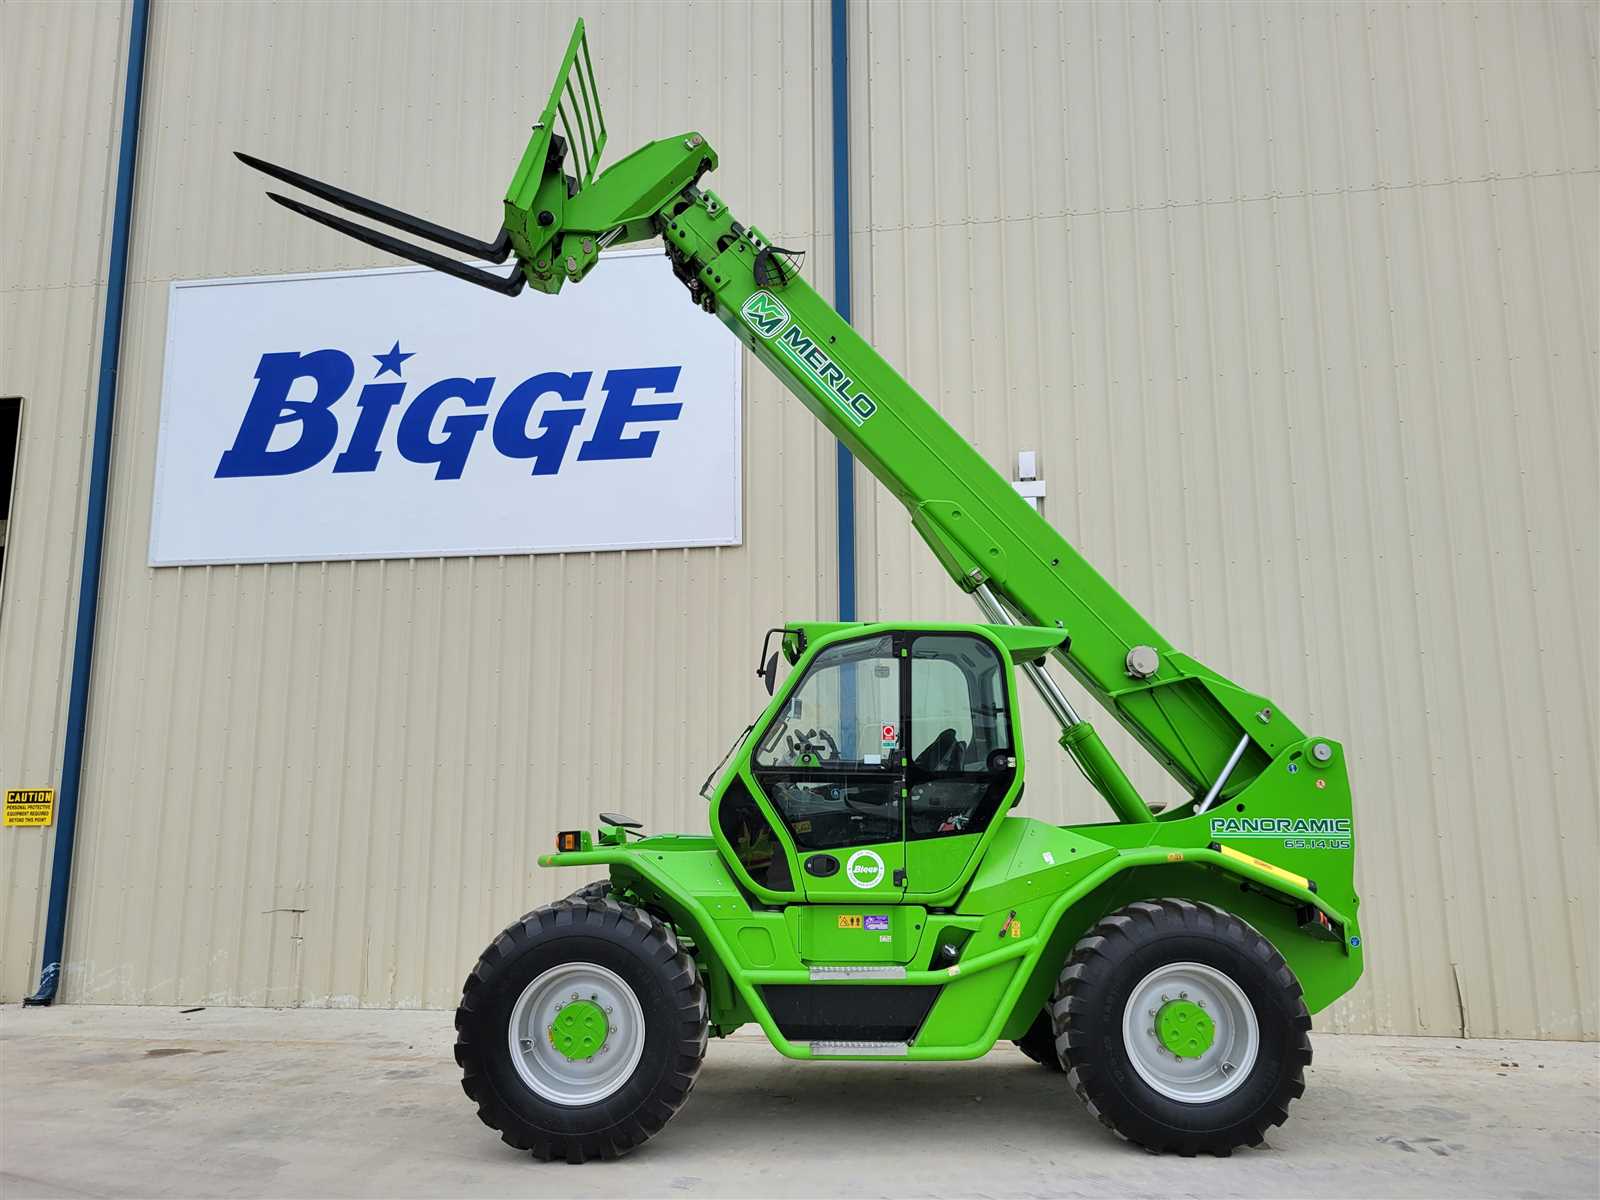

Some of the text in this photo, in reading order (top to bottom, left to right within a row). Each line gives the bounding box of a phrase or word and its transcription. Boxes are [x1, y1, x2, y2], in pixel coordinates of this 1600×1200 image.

[781, 324, 877, 419] MERLO
[8, 792, 51, 802] CAUTION
[1210, 818, 1350, 832] PANORAMIC
